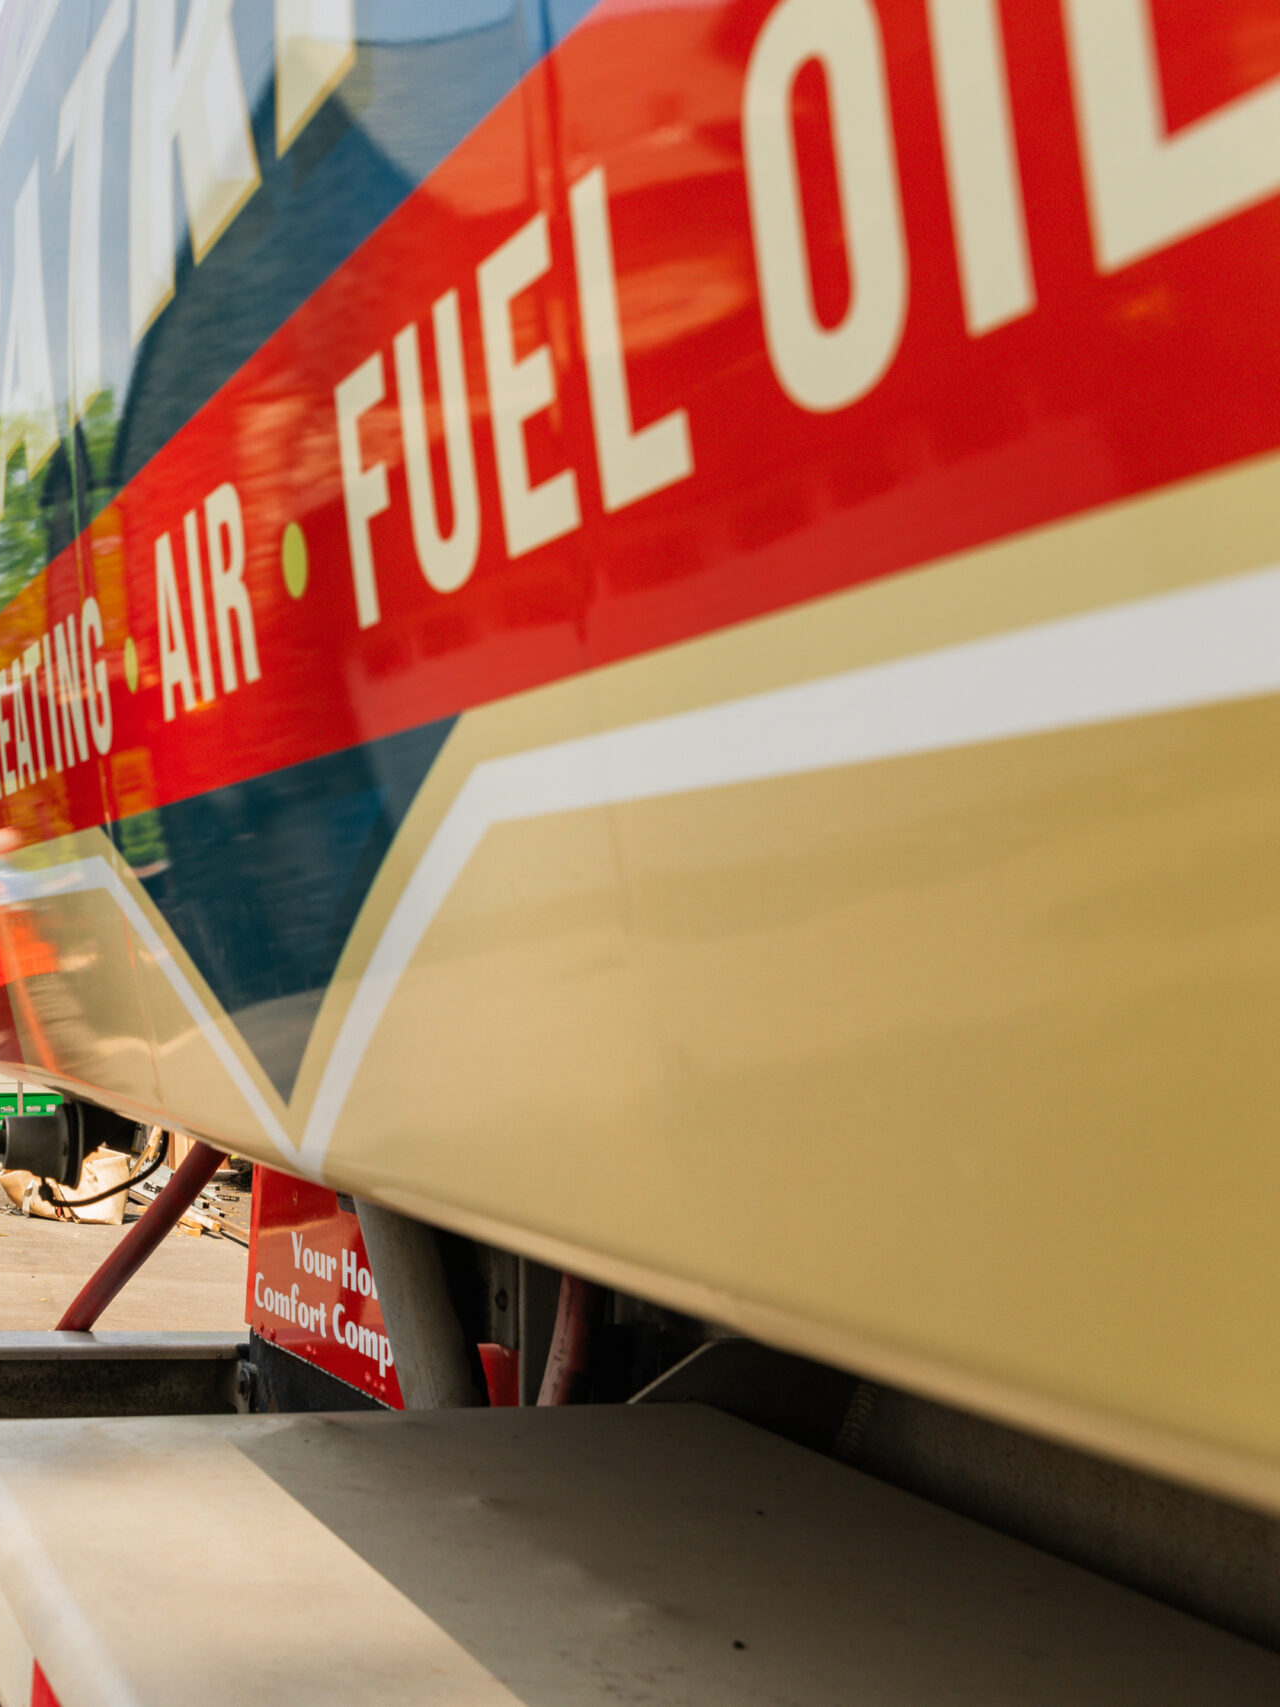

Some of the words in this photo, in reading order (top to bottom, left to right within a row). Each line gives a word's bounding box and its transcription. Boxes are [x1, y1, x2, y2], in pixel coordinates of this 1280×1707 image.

[155, 482, 261, 722] AIR
[334, 164, 695, 630] FUEL
[741, 0, 1280, 414] OIL
[291, 1231, 337, 1282] Your
[254, 1271, 327, 1338] Comfort
